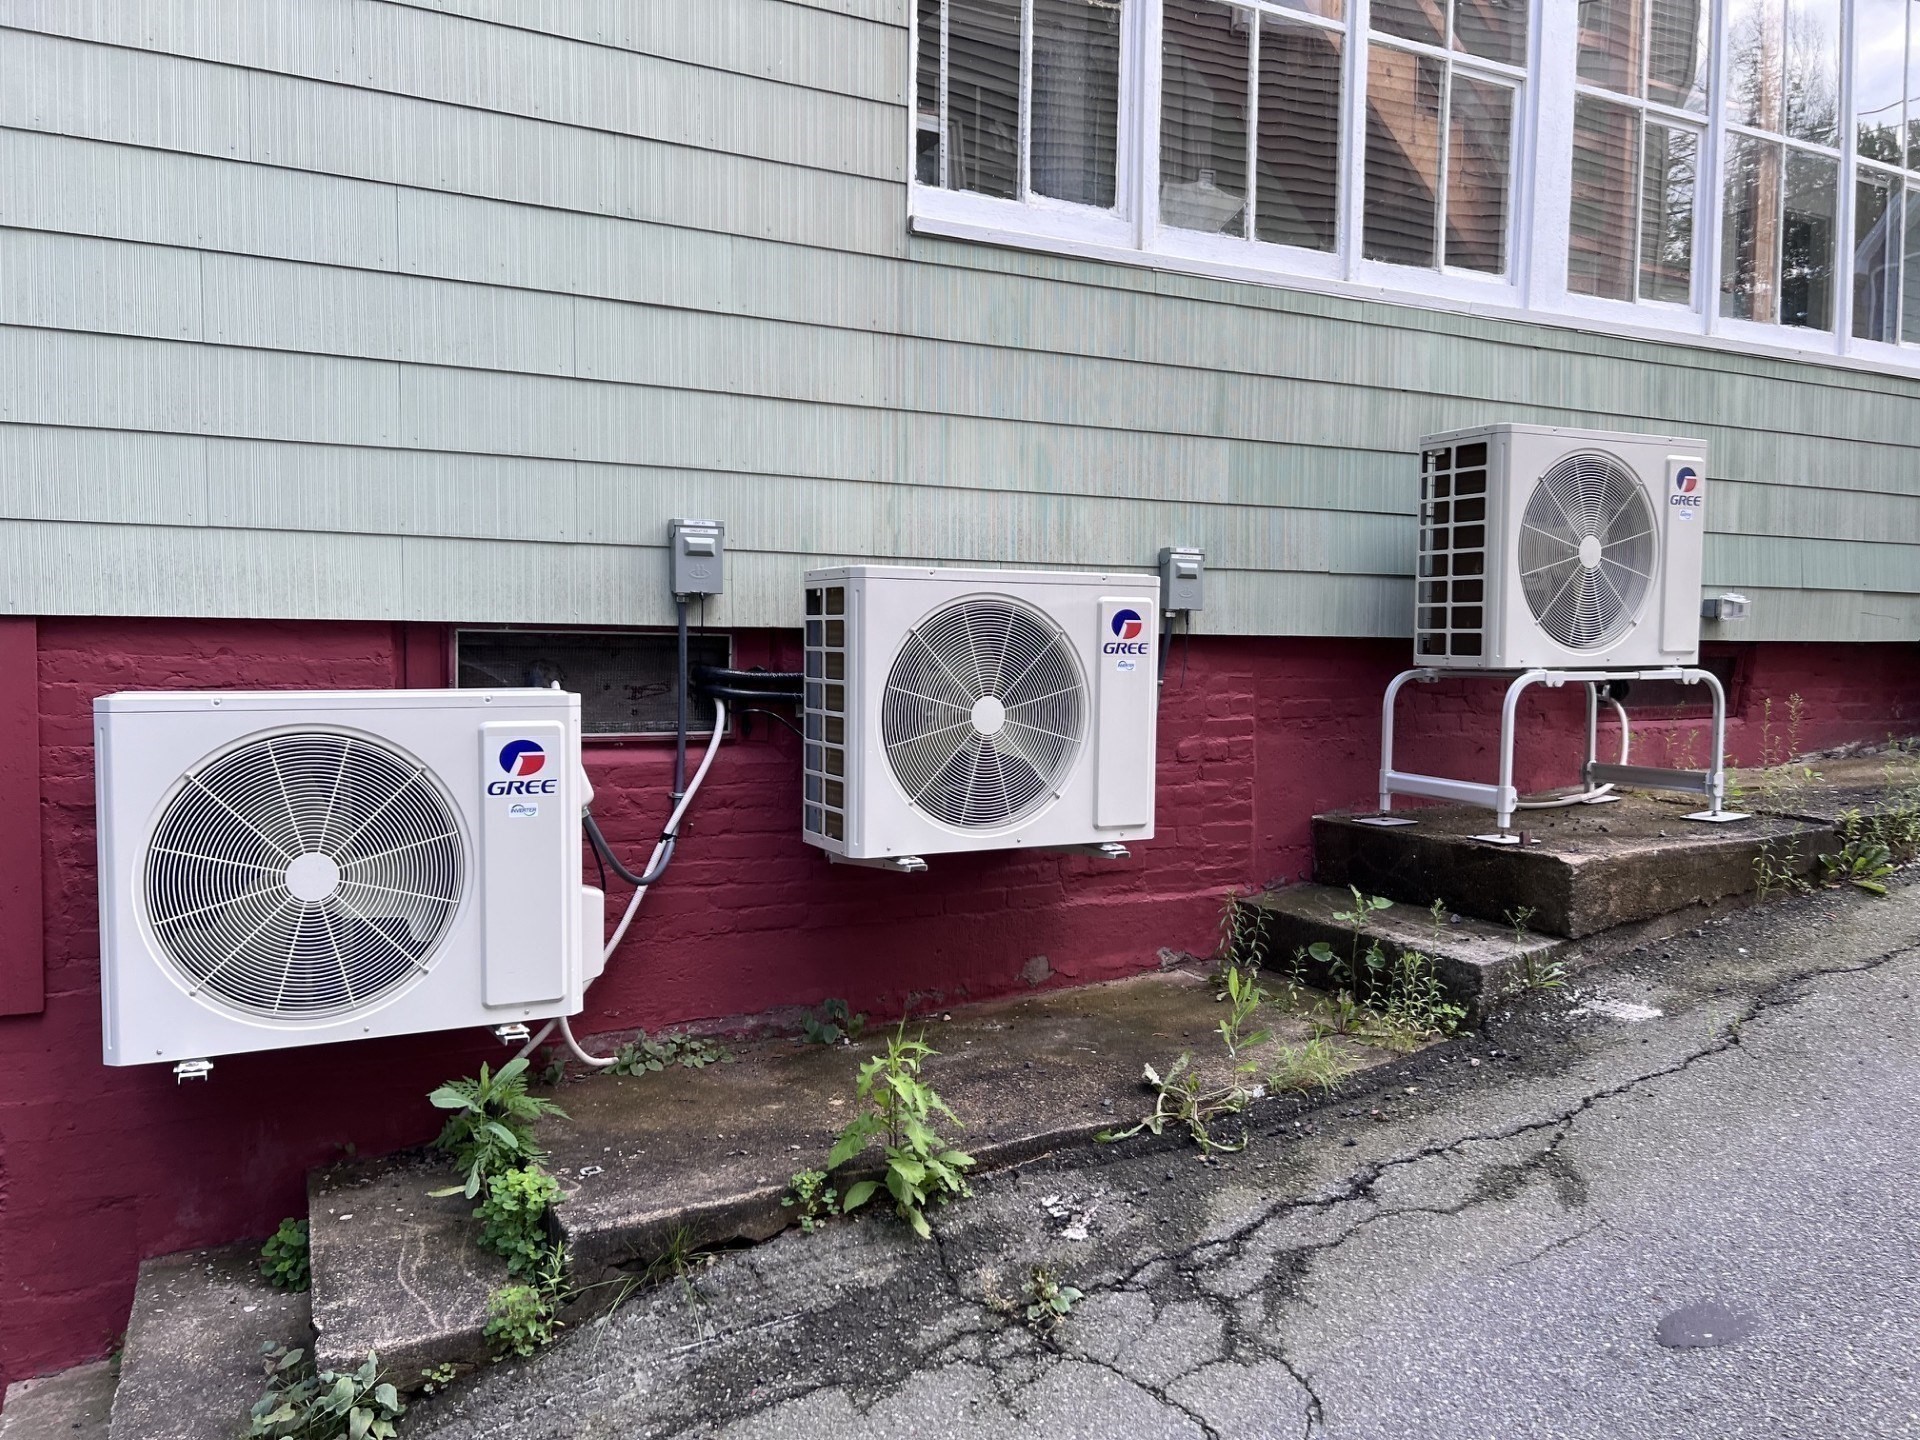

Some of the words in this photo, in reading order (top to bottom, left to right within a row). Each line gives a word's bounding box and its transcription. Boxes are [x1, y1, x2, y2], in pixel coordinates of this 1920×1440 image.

[1670, 494, 1702, 507] GREE
[1103, 642, 1149, 655] GREE
[487, 779, 557, 796] GREE
[510, 806, 537, 814] INVERTER
